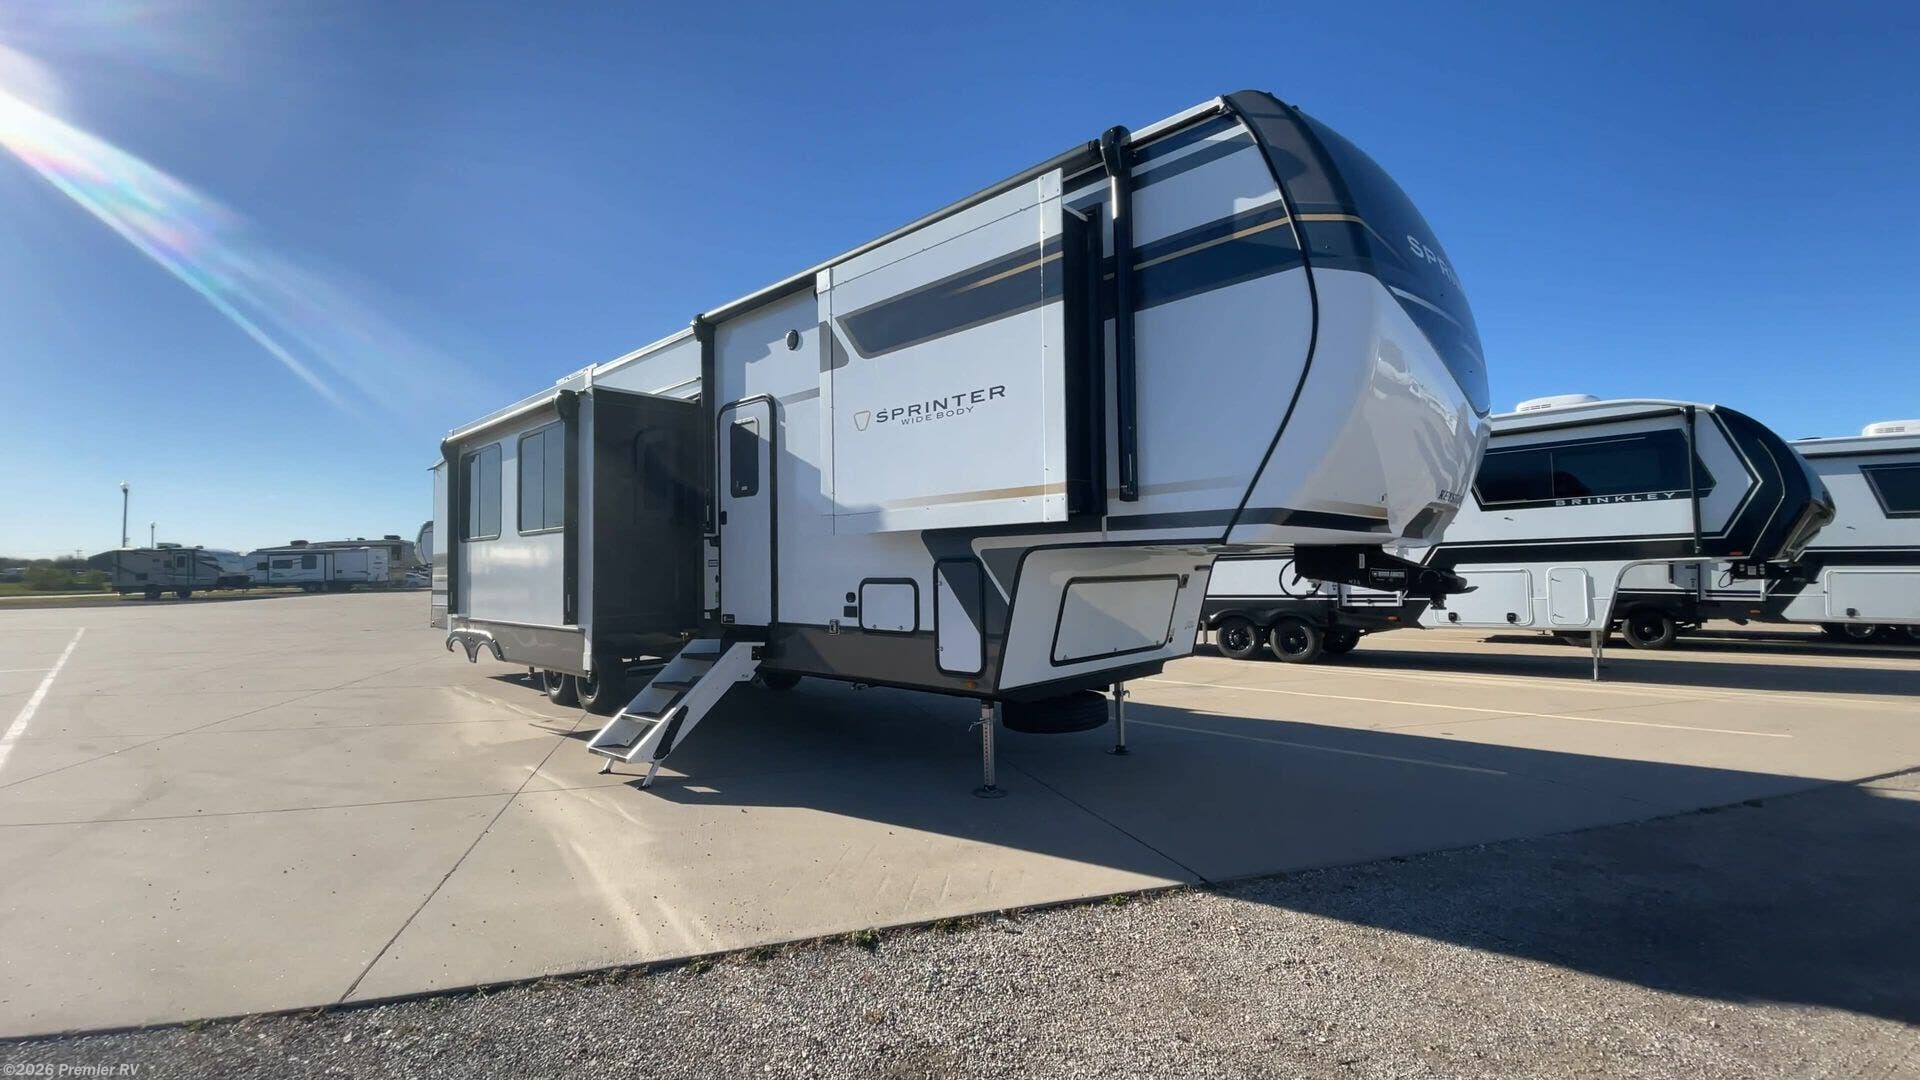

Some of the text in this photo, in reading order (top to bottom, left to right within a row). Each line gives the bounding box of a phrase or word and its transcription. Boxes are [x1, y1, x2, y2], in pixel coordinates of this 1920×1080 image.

[876, 385, 1006, 423] SPRINTER
[901, 406, 974, 425] WIDE BODY
[1555, 492, 1676, 506] BRINKLEY
